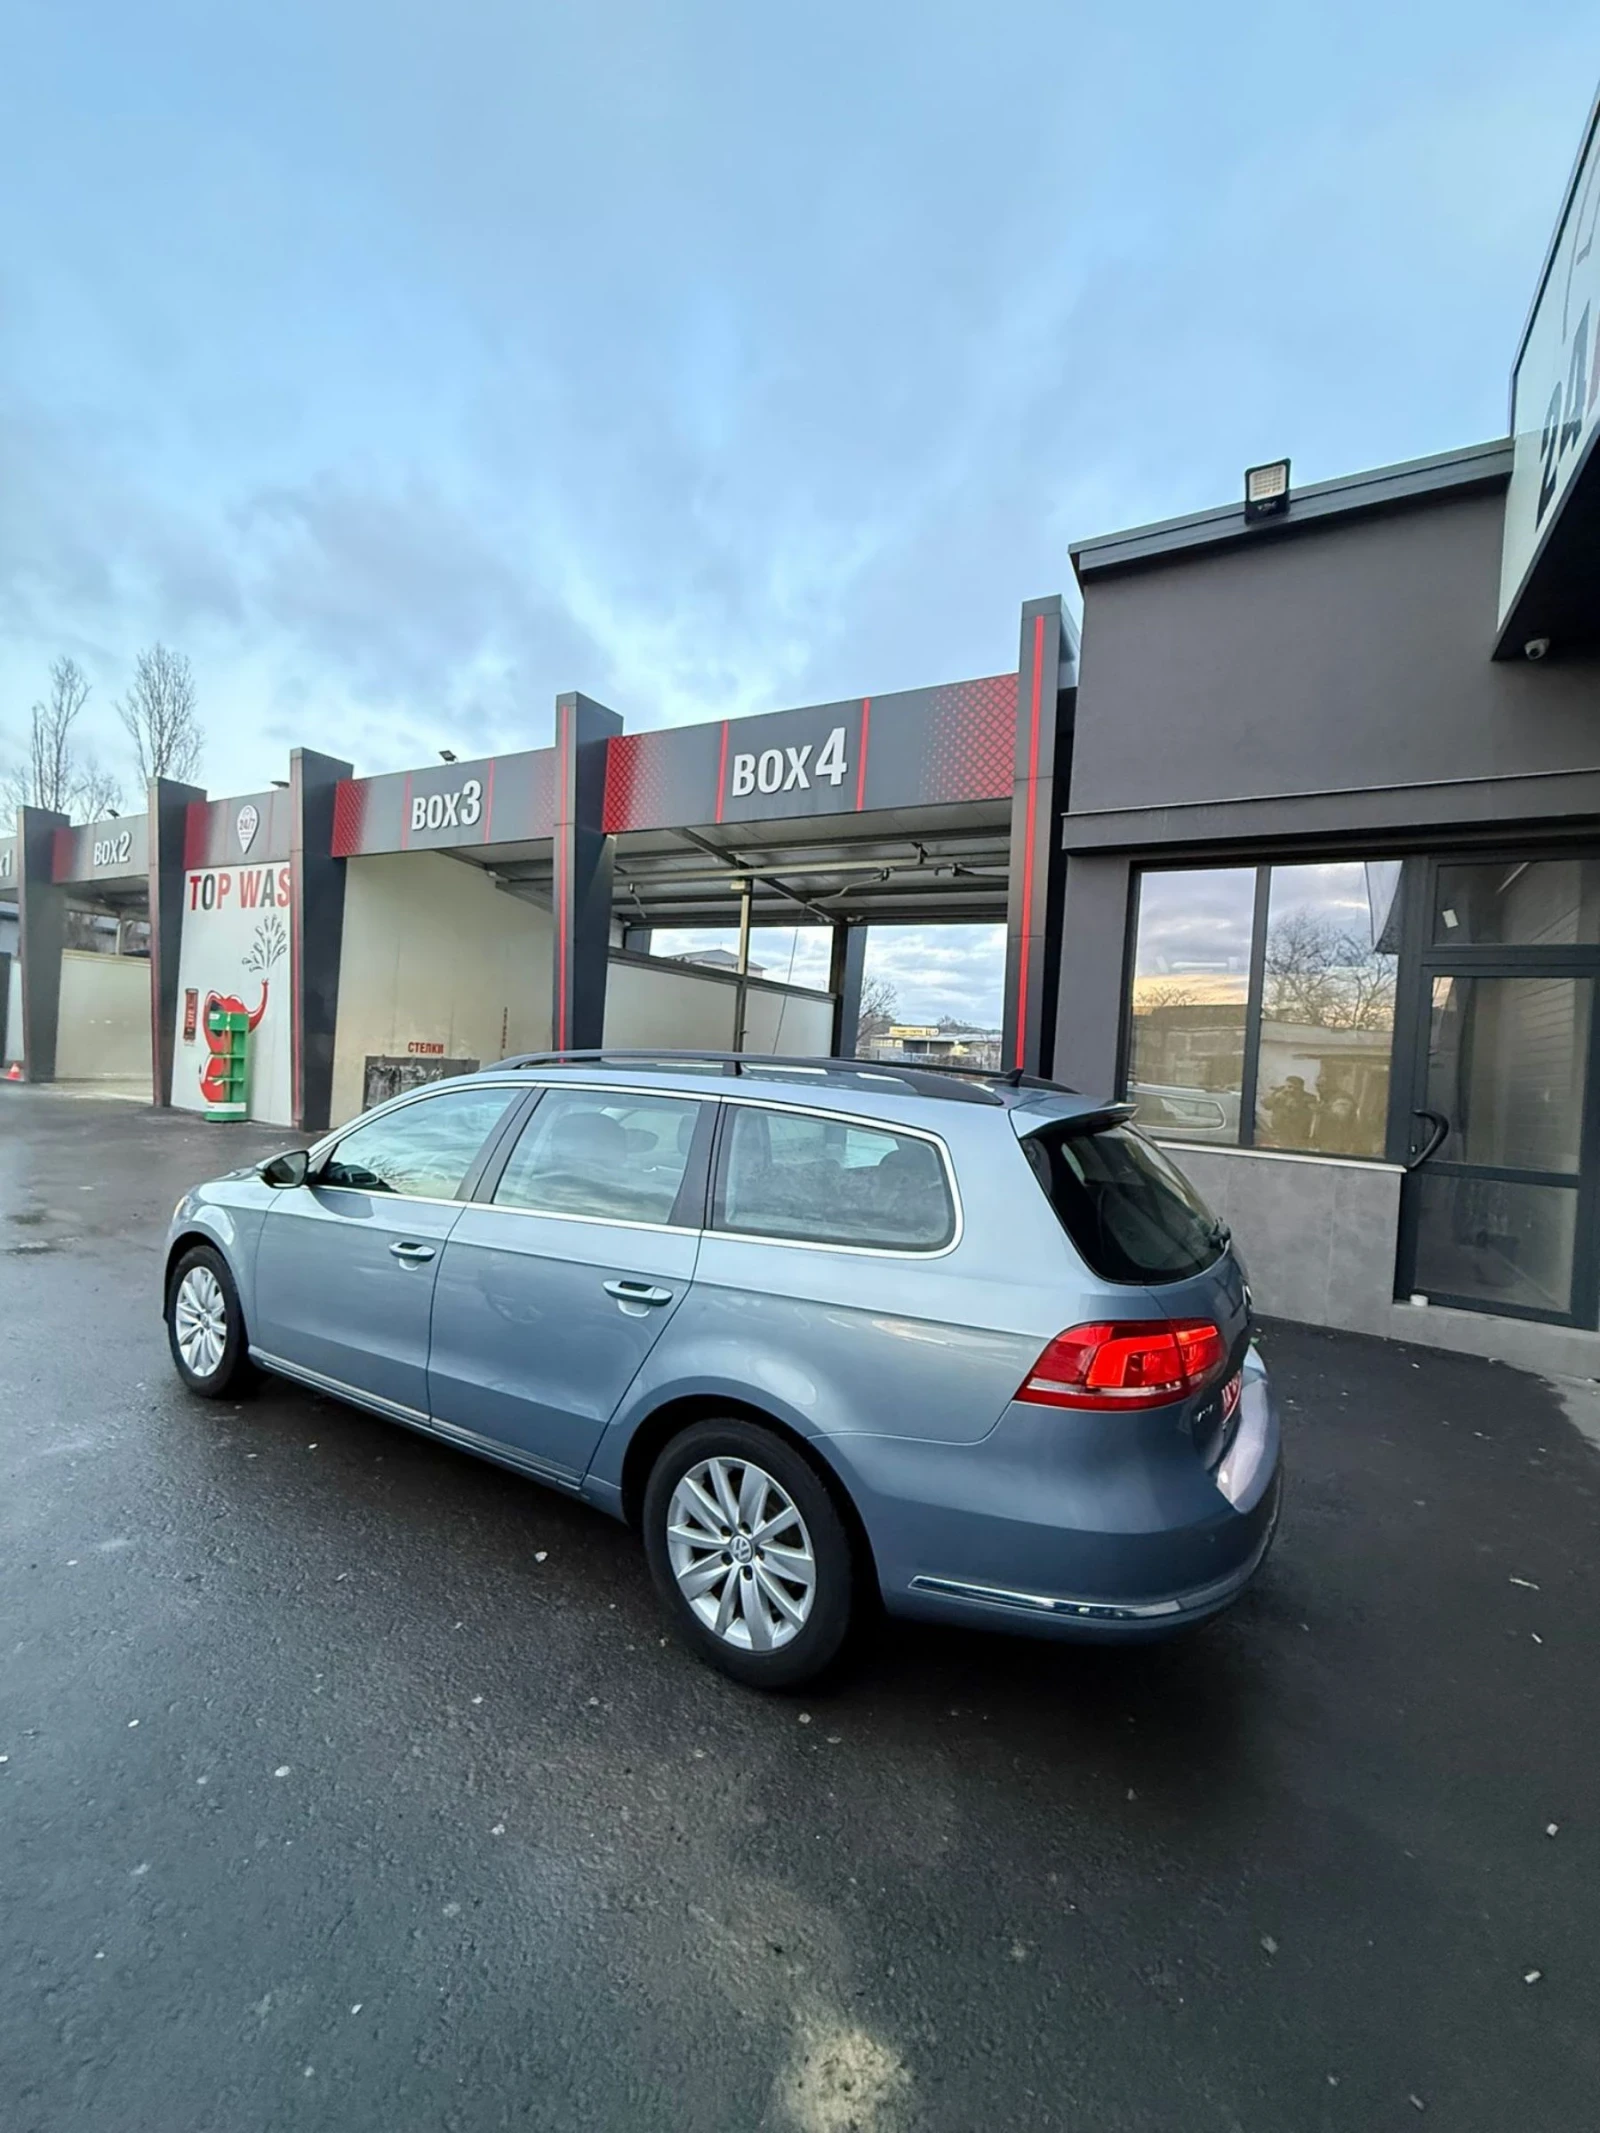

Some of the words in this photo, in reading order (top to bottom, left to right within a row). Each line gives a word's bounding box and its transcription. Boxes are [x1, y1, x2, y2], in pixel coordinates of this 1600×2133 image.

[732, 727, 848, 797] BOX4
[411, 779, 482, 831] BOX3
[93, 830, 132, 867] BOX2
[189, 872, 232, 911] TOP
[239, 867, 291, 909] WAS
[407, 1041, 444, 1054] СТЕЛКИ
